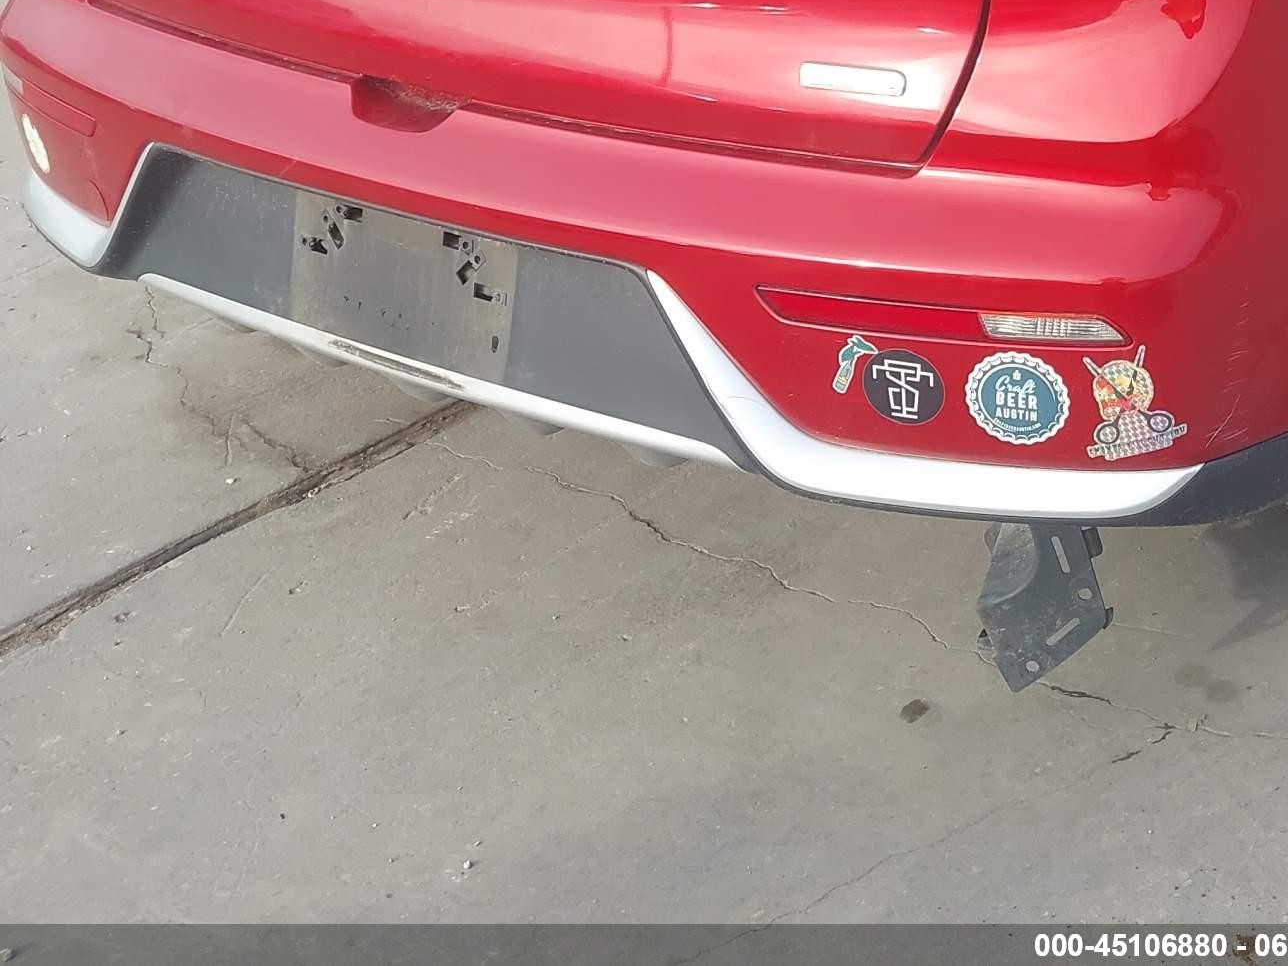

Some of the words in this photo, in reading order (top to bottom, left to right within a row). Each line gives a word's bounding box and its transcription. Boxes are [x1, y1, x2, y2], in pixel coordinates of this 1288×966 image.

[995, 375, 1036, 394] Craft
[995, 391, 1038, 410] BEER
[995, 406, 1038, 422] AUSTIN
